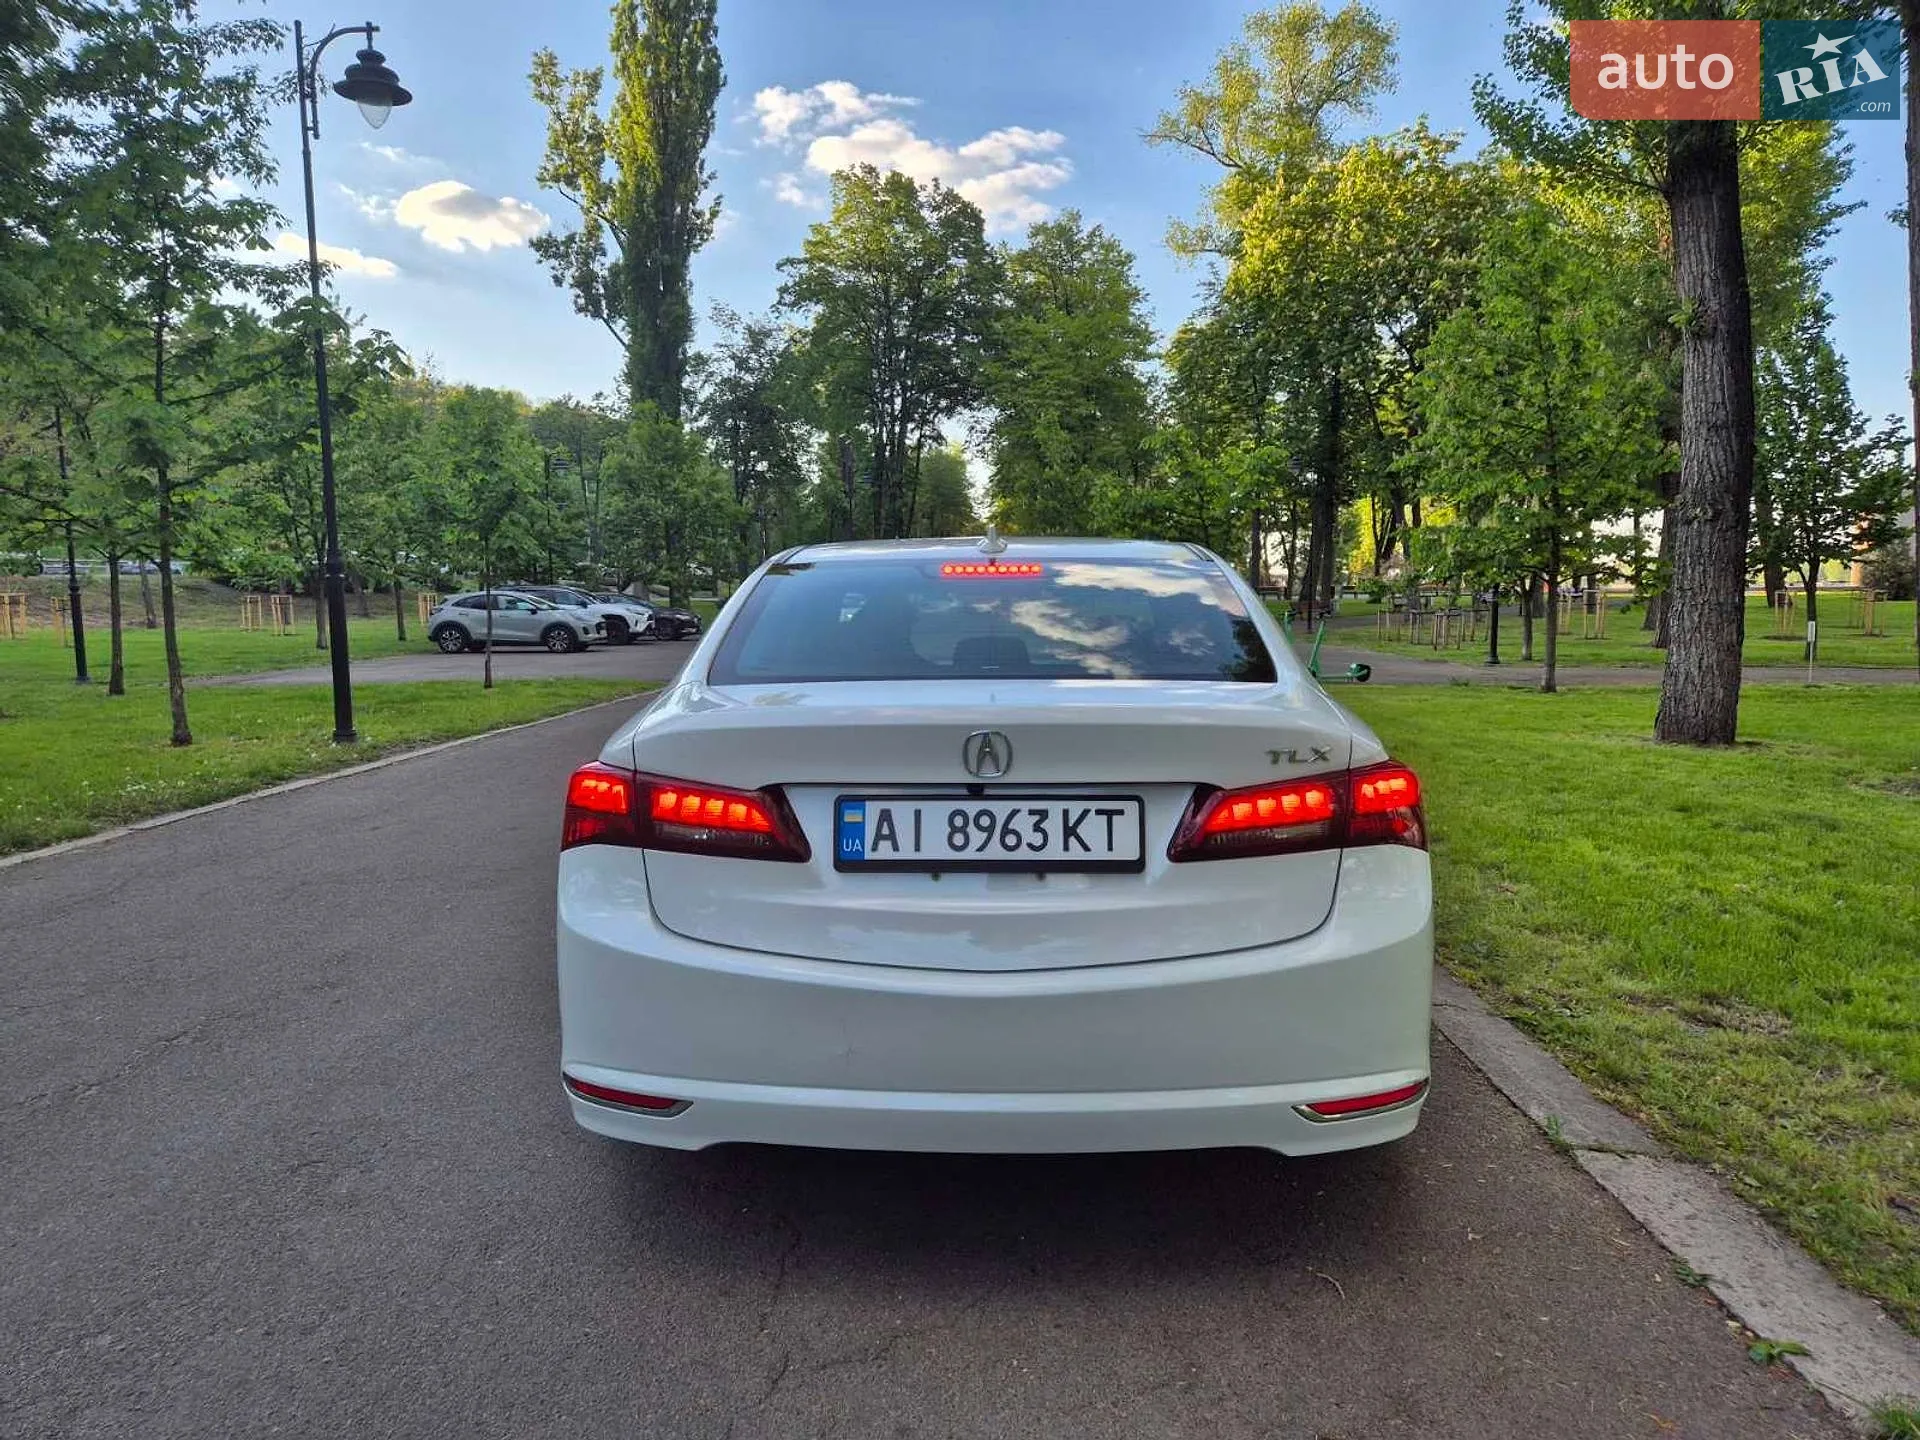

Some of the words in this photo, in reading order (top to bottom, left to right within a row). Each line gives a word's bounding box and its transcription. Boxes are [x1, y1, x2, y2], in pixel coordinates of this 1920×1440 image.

[1265, 744, 1331, 765] TLX
[871, 808, 922, 852] AI
[947, 808, 1049, 852] 8963
[1062, 808, 1125, 852] KT
[843, 840, 863, 852] UA
